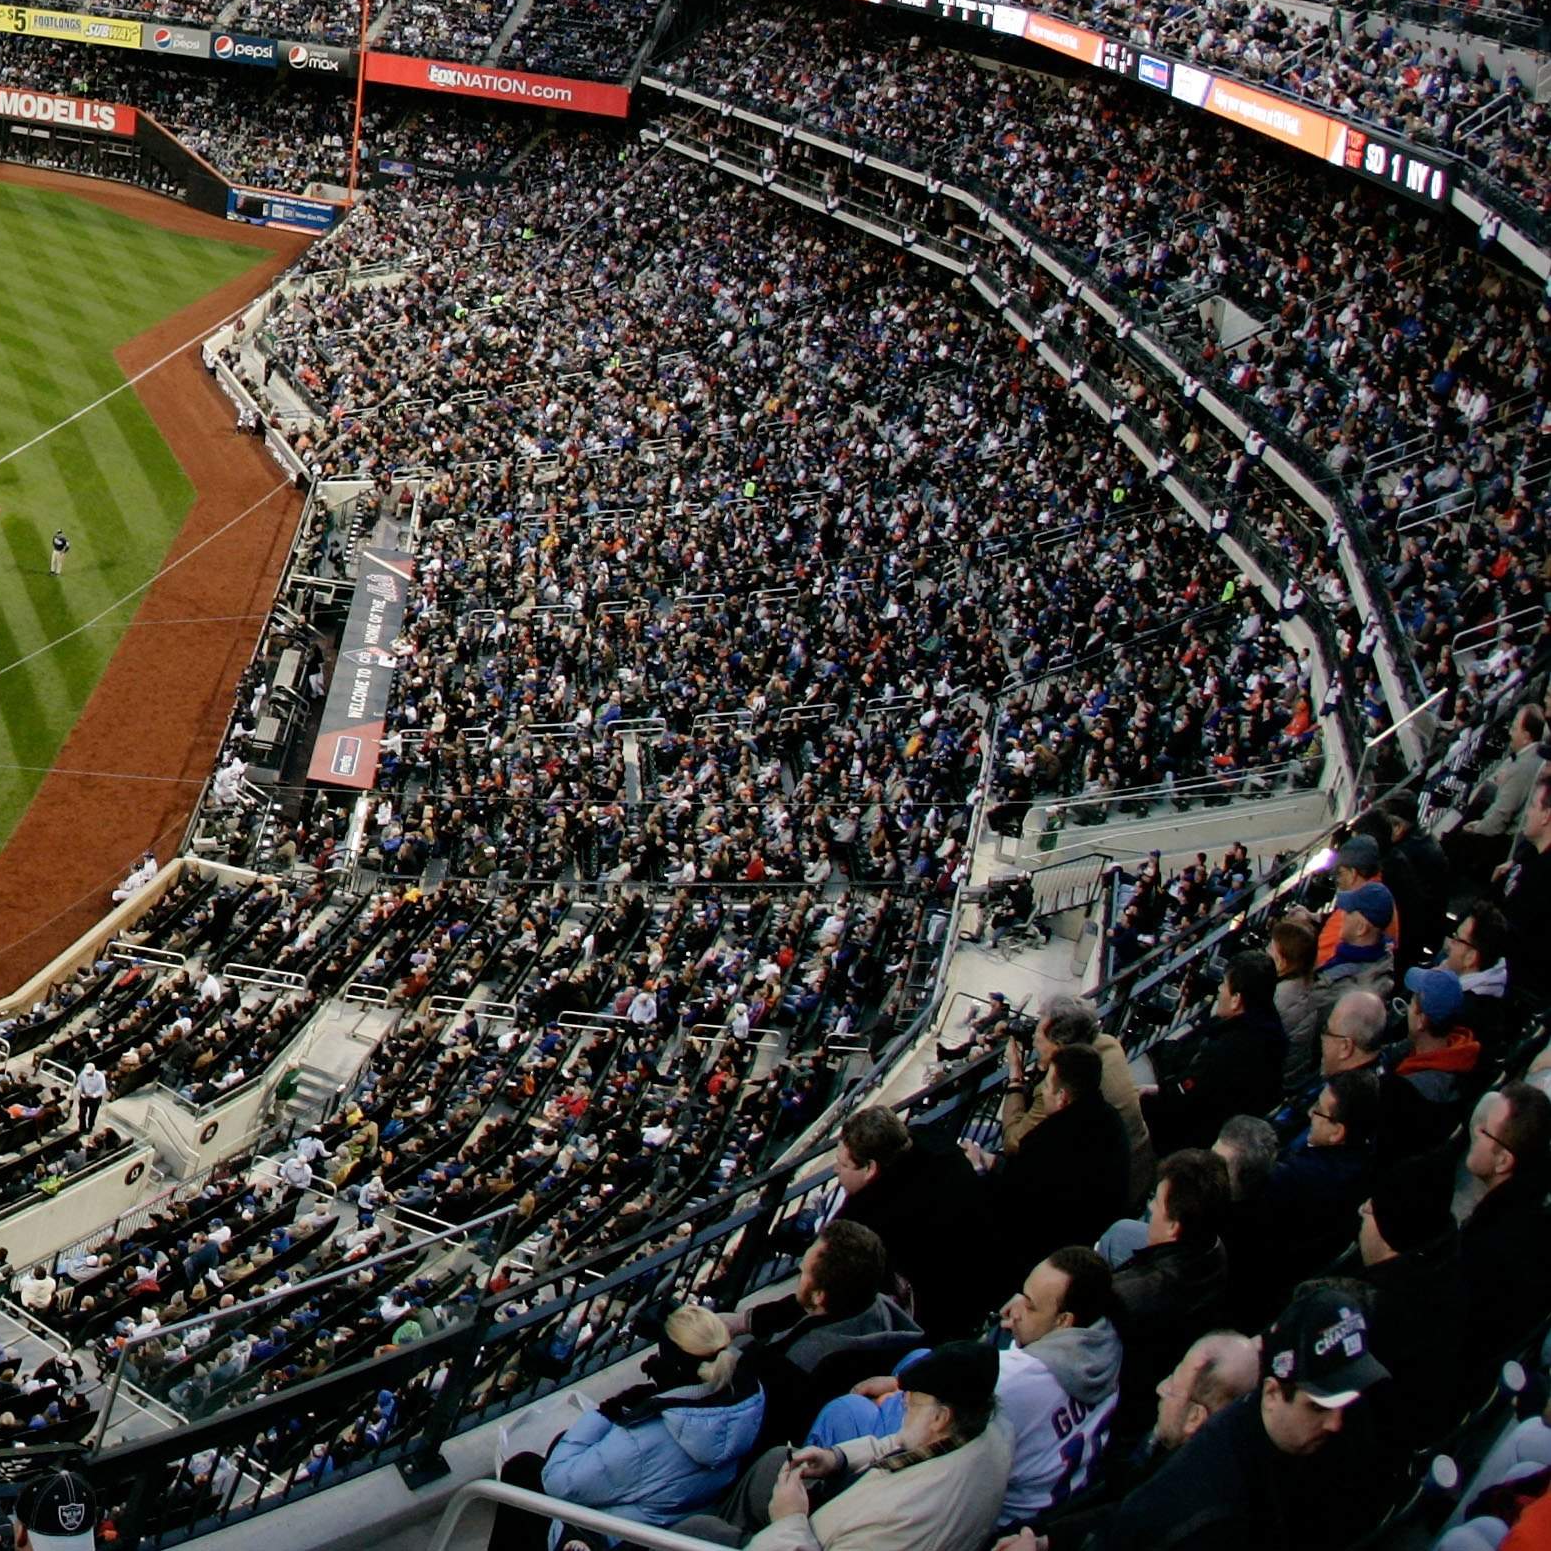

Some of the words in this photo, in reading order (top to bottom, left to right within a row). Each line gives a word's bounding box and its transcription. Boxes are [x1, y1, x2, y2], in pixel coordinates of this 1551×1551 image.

[7, 9, 26, 32] $5
[33, 15, 81, 31] FOOTLONGS
[86, 23, 138, 41] SUBWAY
[234, 44, 273, 59] pepsi
[309, 57, 339, 72] max
[1365, 143, 1385, 174] SD
[1391, 154, 1400, 182] 1
[1407, 160, 1429, 193] NY
[1431, 170, 1443, 200] 0
[371, 599, 387, 614] THE
[369, 613, 383, 624] OF
[364, 623, 382, 645] HOME
[356, 668, 372, 679] TO
[348, 680, 370, 719] WELCOME
